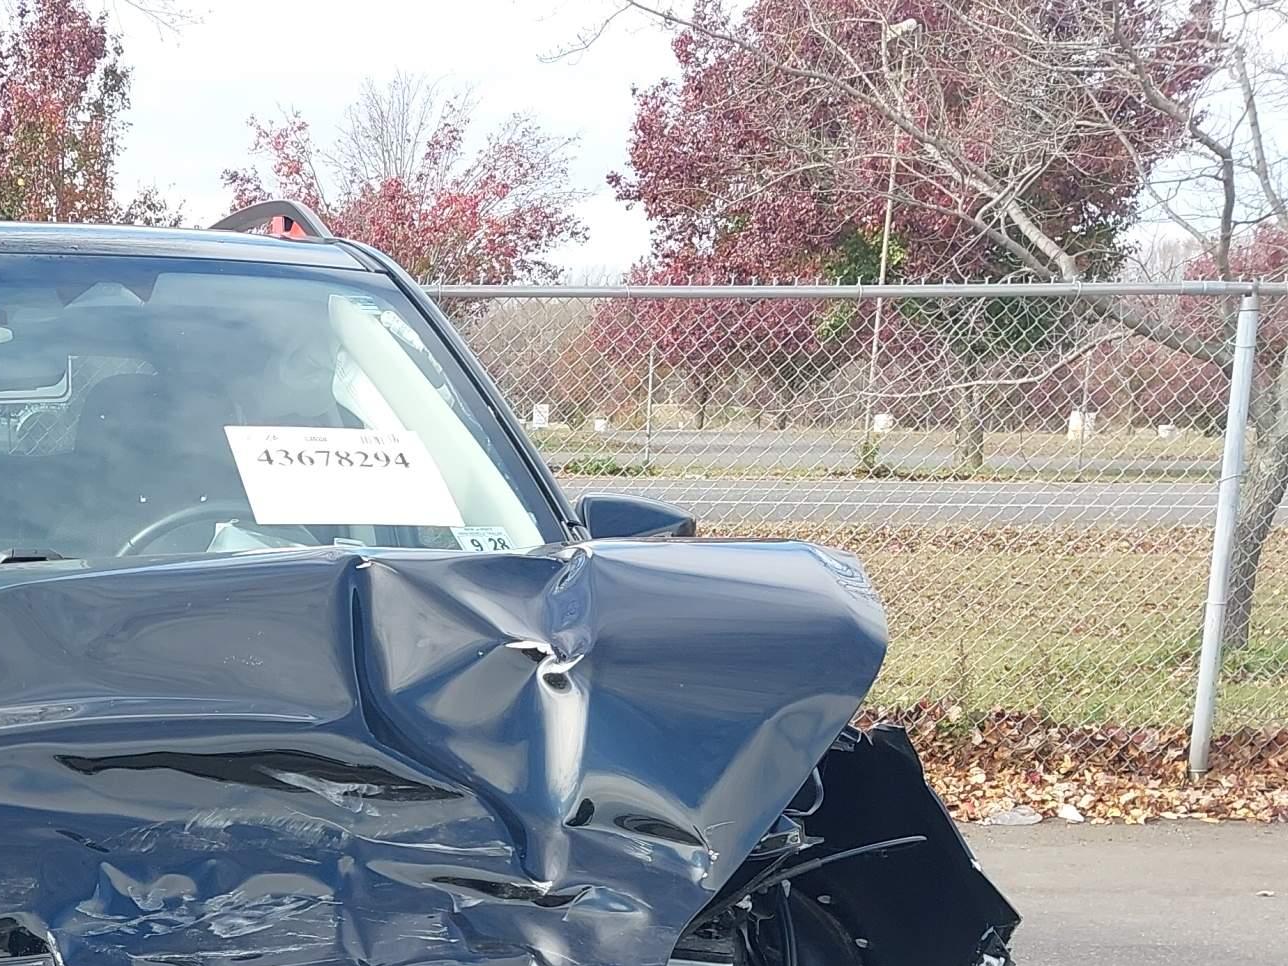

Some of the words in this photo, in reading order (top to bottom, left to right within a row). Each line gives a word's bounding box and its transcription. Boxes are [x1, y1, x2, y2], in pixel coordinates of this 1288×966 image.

[256, 448, 411, 469] 43678294
[470, 538, 484, 552] 9
[488, 537, 511, 551] 28
